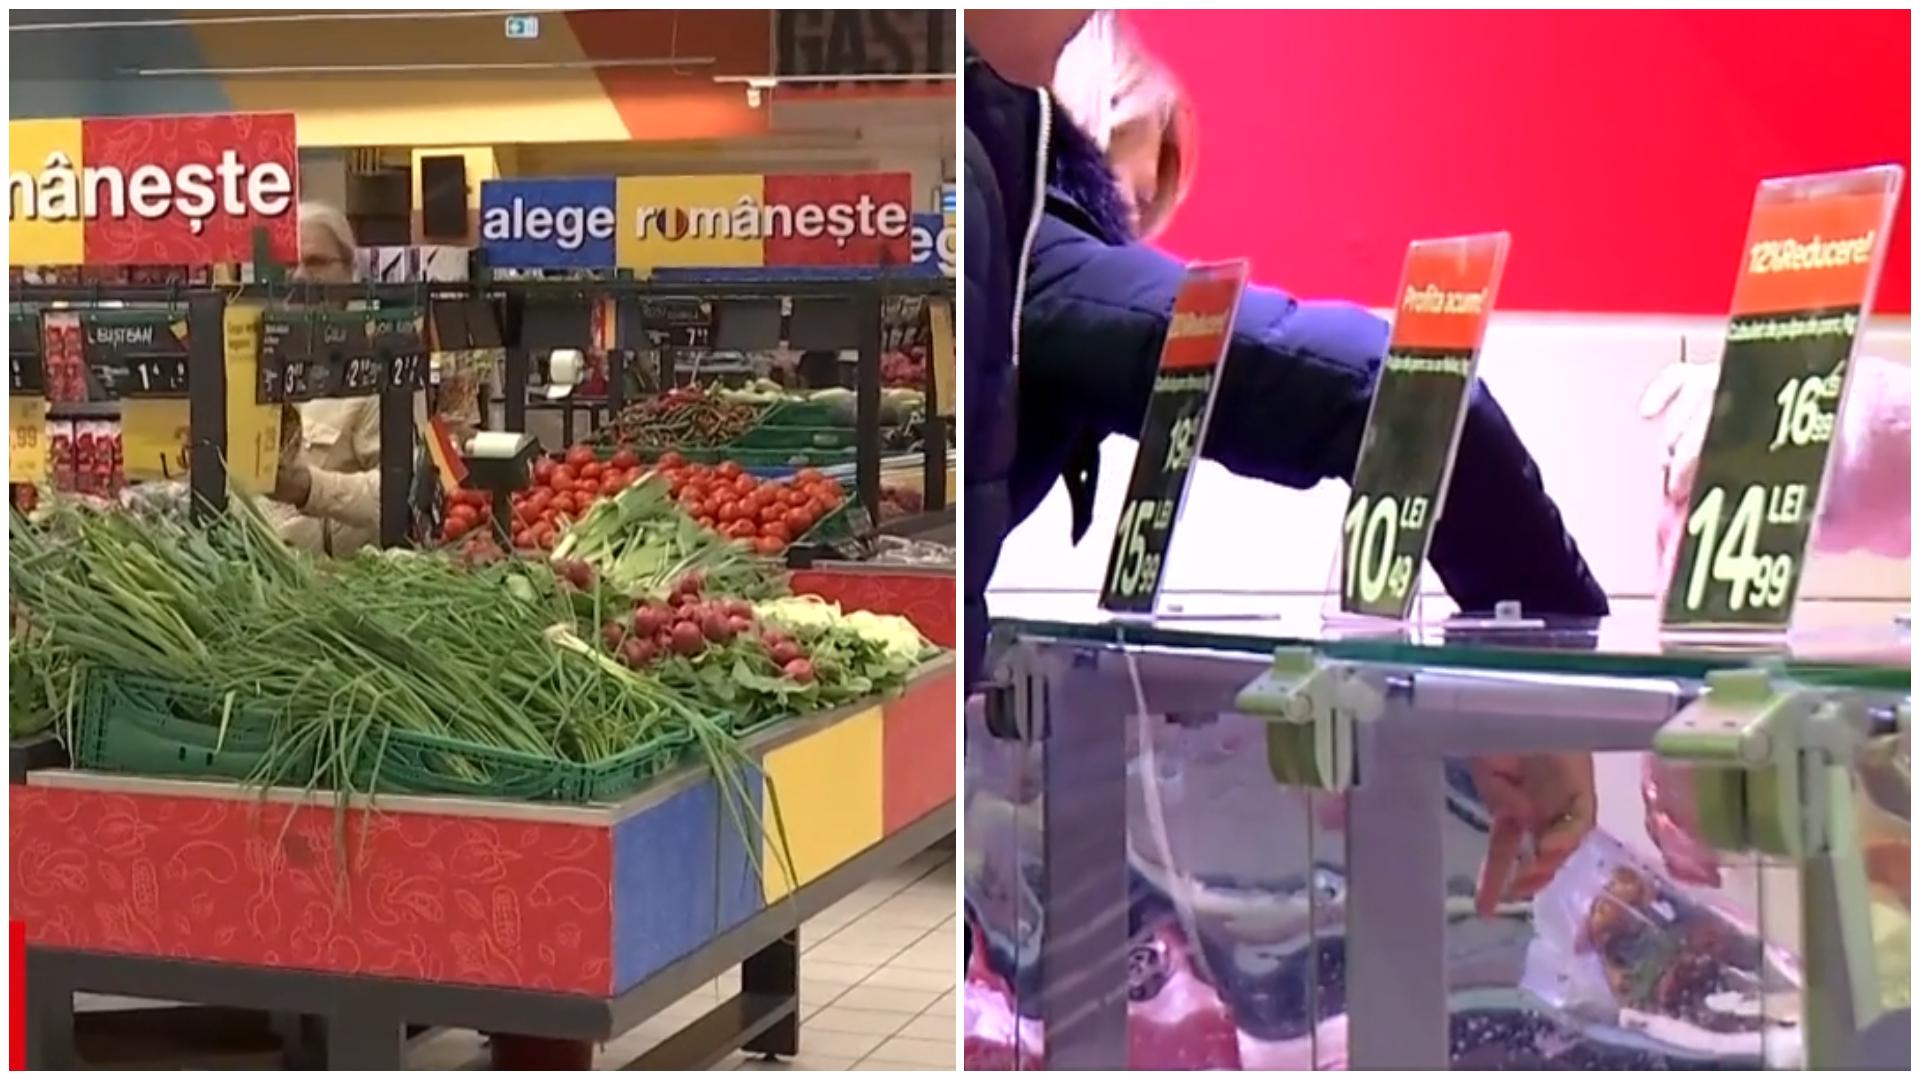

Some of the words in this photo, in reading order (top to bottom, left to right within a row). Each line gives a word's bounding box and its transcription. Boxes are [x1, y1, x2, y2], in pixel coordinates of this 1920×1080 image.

[483, 197, 614, 249] alege
[635, 193, 908, 249] românește
[1774, 375, 1821, 449] 16
[1112, 499, 1156, 596] 15
[1345, 494, 1399, 603] 10
[1400, 496, 1429, 529] LEI
[1388, 555, 1414, 598] 49
[1687, 484, 1767, 612] 14
[1768, 484, 1808, 523] LEI
[1748, 554, 1792, 607] 99
